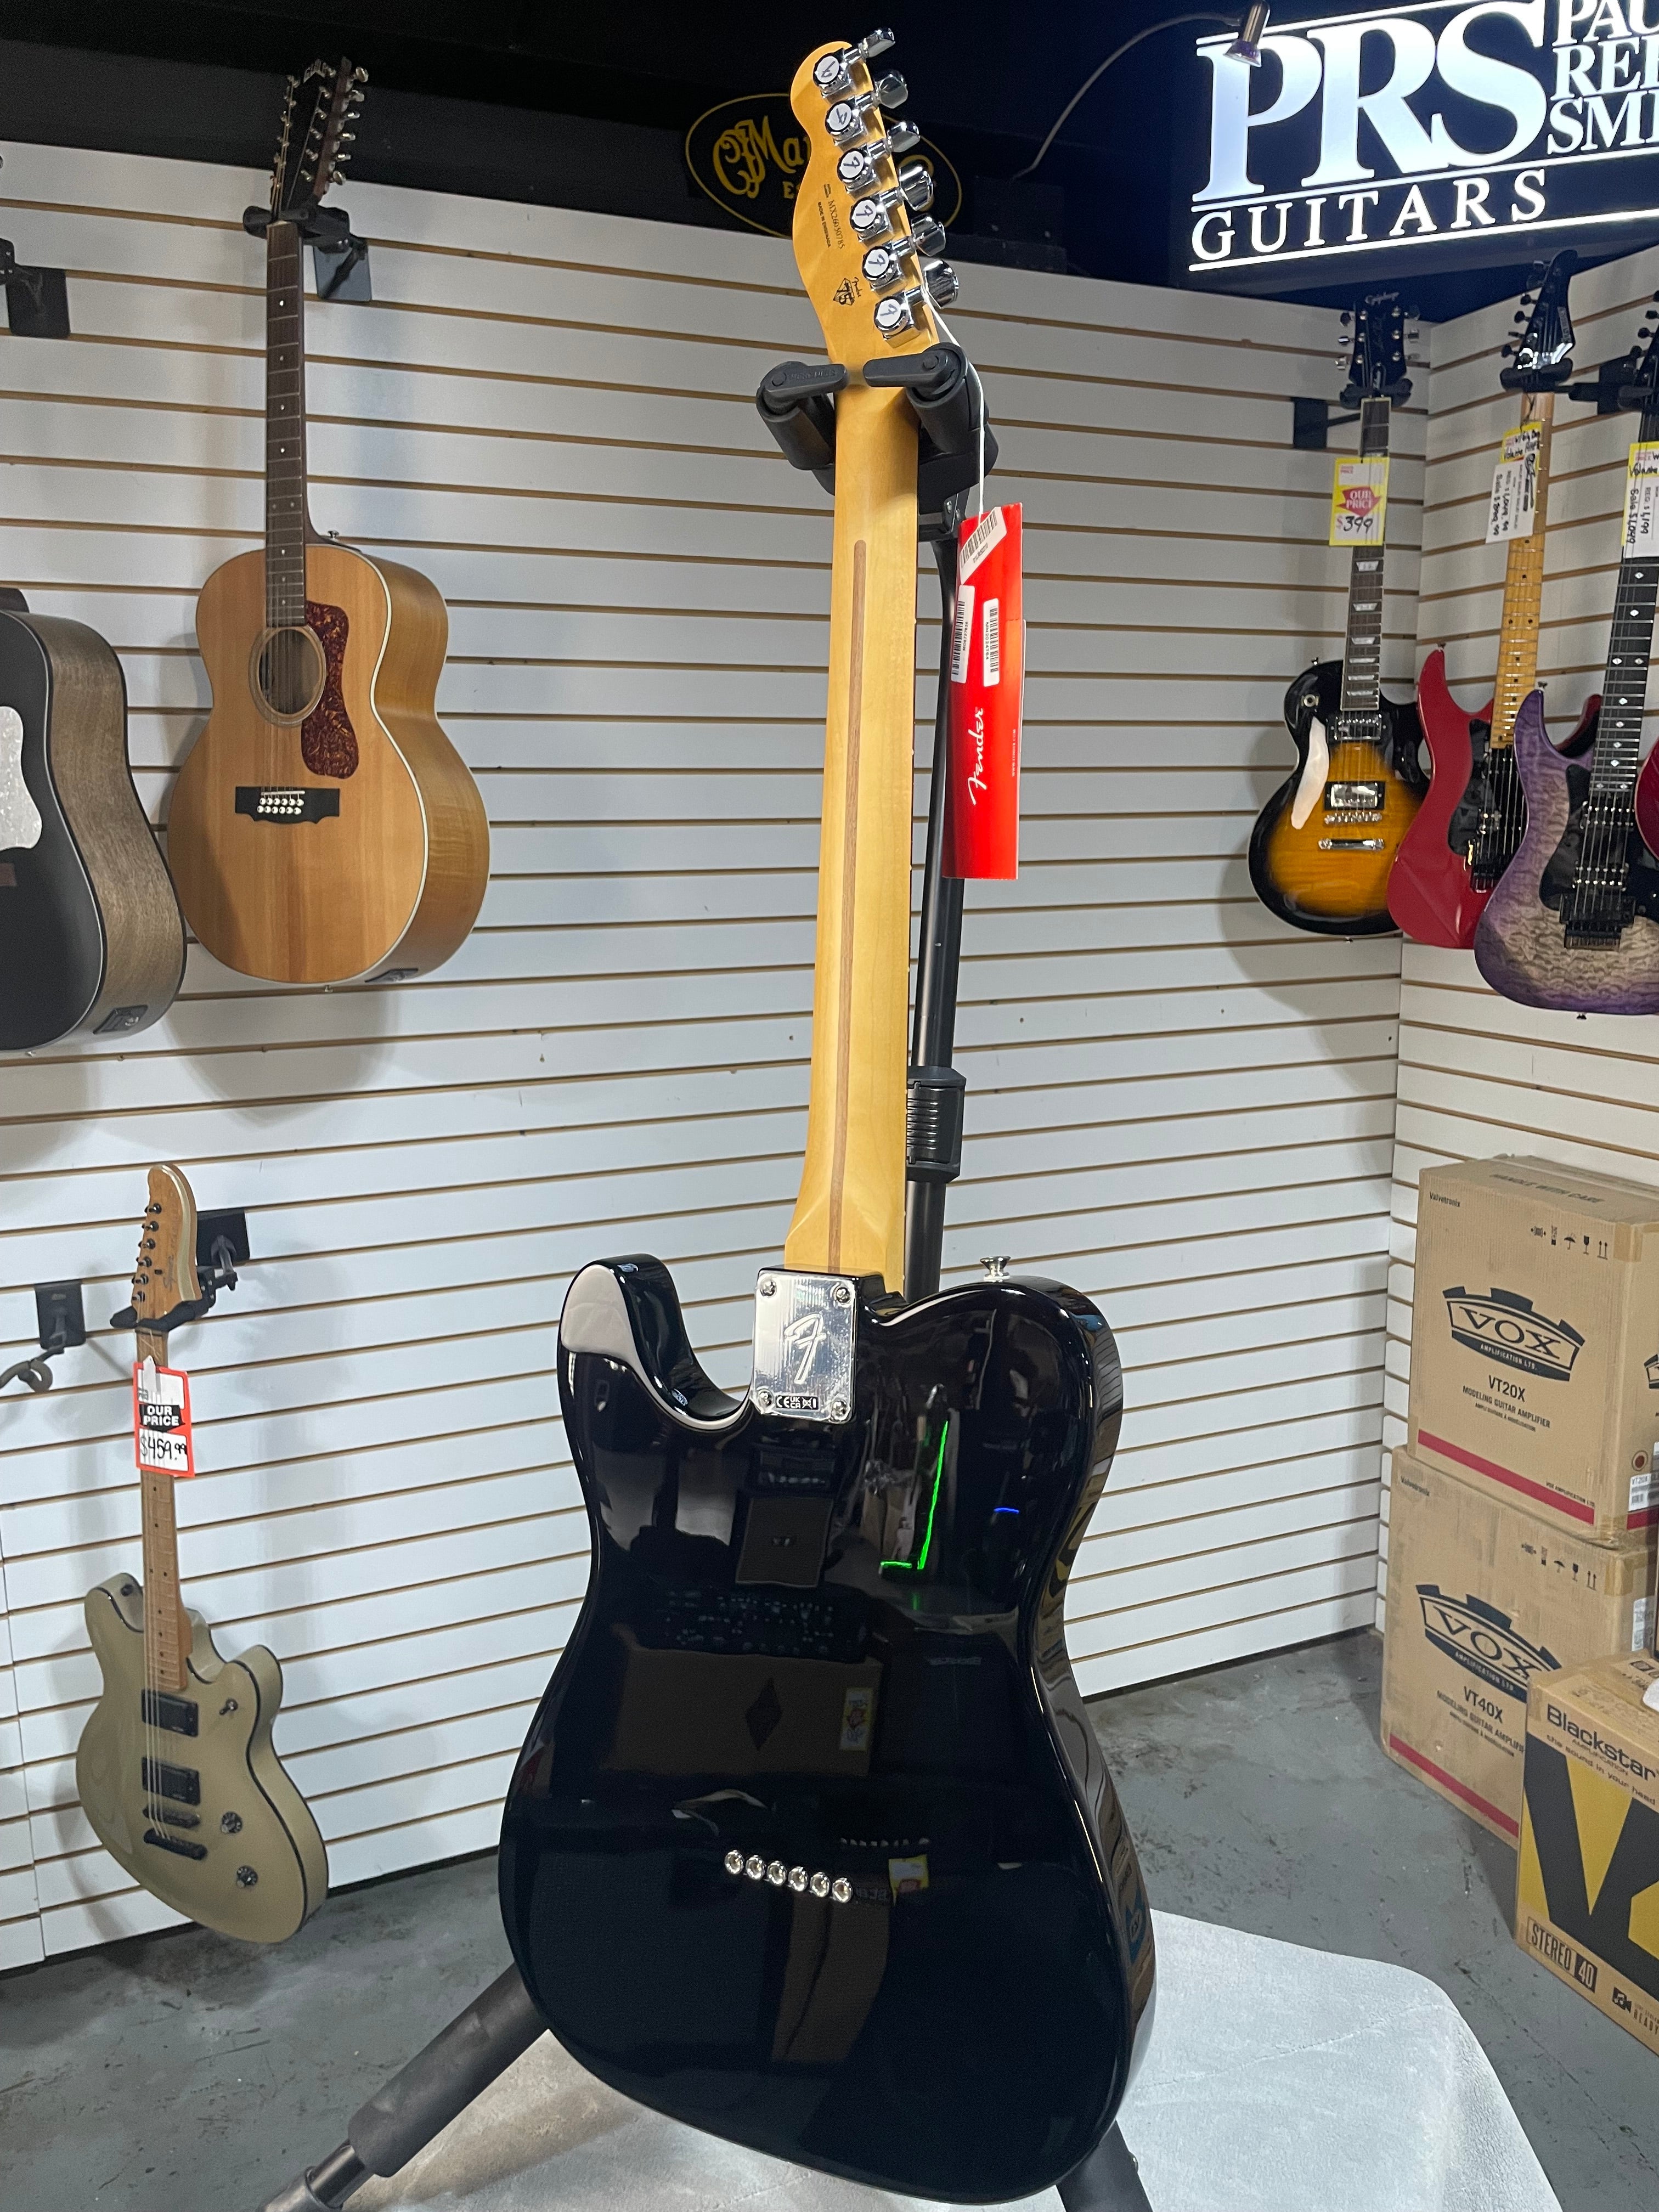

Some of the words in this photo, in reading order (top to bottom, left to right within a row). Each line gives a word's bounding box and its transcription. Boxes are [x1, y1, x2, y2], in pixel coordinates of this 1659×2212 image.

[1552, 0, 1659, 47] PAU
[1192, 1, 1547, 202] PRS
[1192, 168, 1547, 261] GUITARS
[968, 707, 987, 805] Fender
[1430, 1191, 1460, 1207] Valvetronix
[1459, 1306, 1561, 1359] VOX
[1481, 1344, 1522, 1364] AMPLIFICATION
[146, 1405, 172, 1416] OUR
[1463, 1385, 1493, 1404] MODELING
[1494, 1398, 1516, 1414] GUITAR
[1517, 1408, 1550, 1428] AMPLIFIER
[1488, 1374, 1526, 1402] VT20X
[143, 1415, 179, 1426] PRICE
[140, 1431, 187, 1461] $459.99
[1433, 1605, 1542, 1680] VOX
[1464, 1685, 1503, 1724] VT40X
[1547, 1703, 1656, 1781] Blackstar
[1547, 1734, 1563, 1748] the
[1565, 1746, 1594, 1767] sound
[1595, 1763, 1605, 1774] in
[1607, 1771, 1630, 1787] your
[1632, 1786, 1656, 1805] head
[1531, 1923, 1572, 1971] STEREO
[1578, 1960, 1595, 1988] 40
[1633, 2008, 1659, 2035] READY
